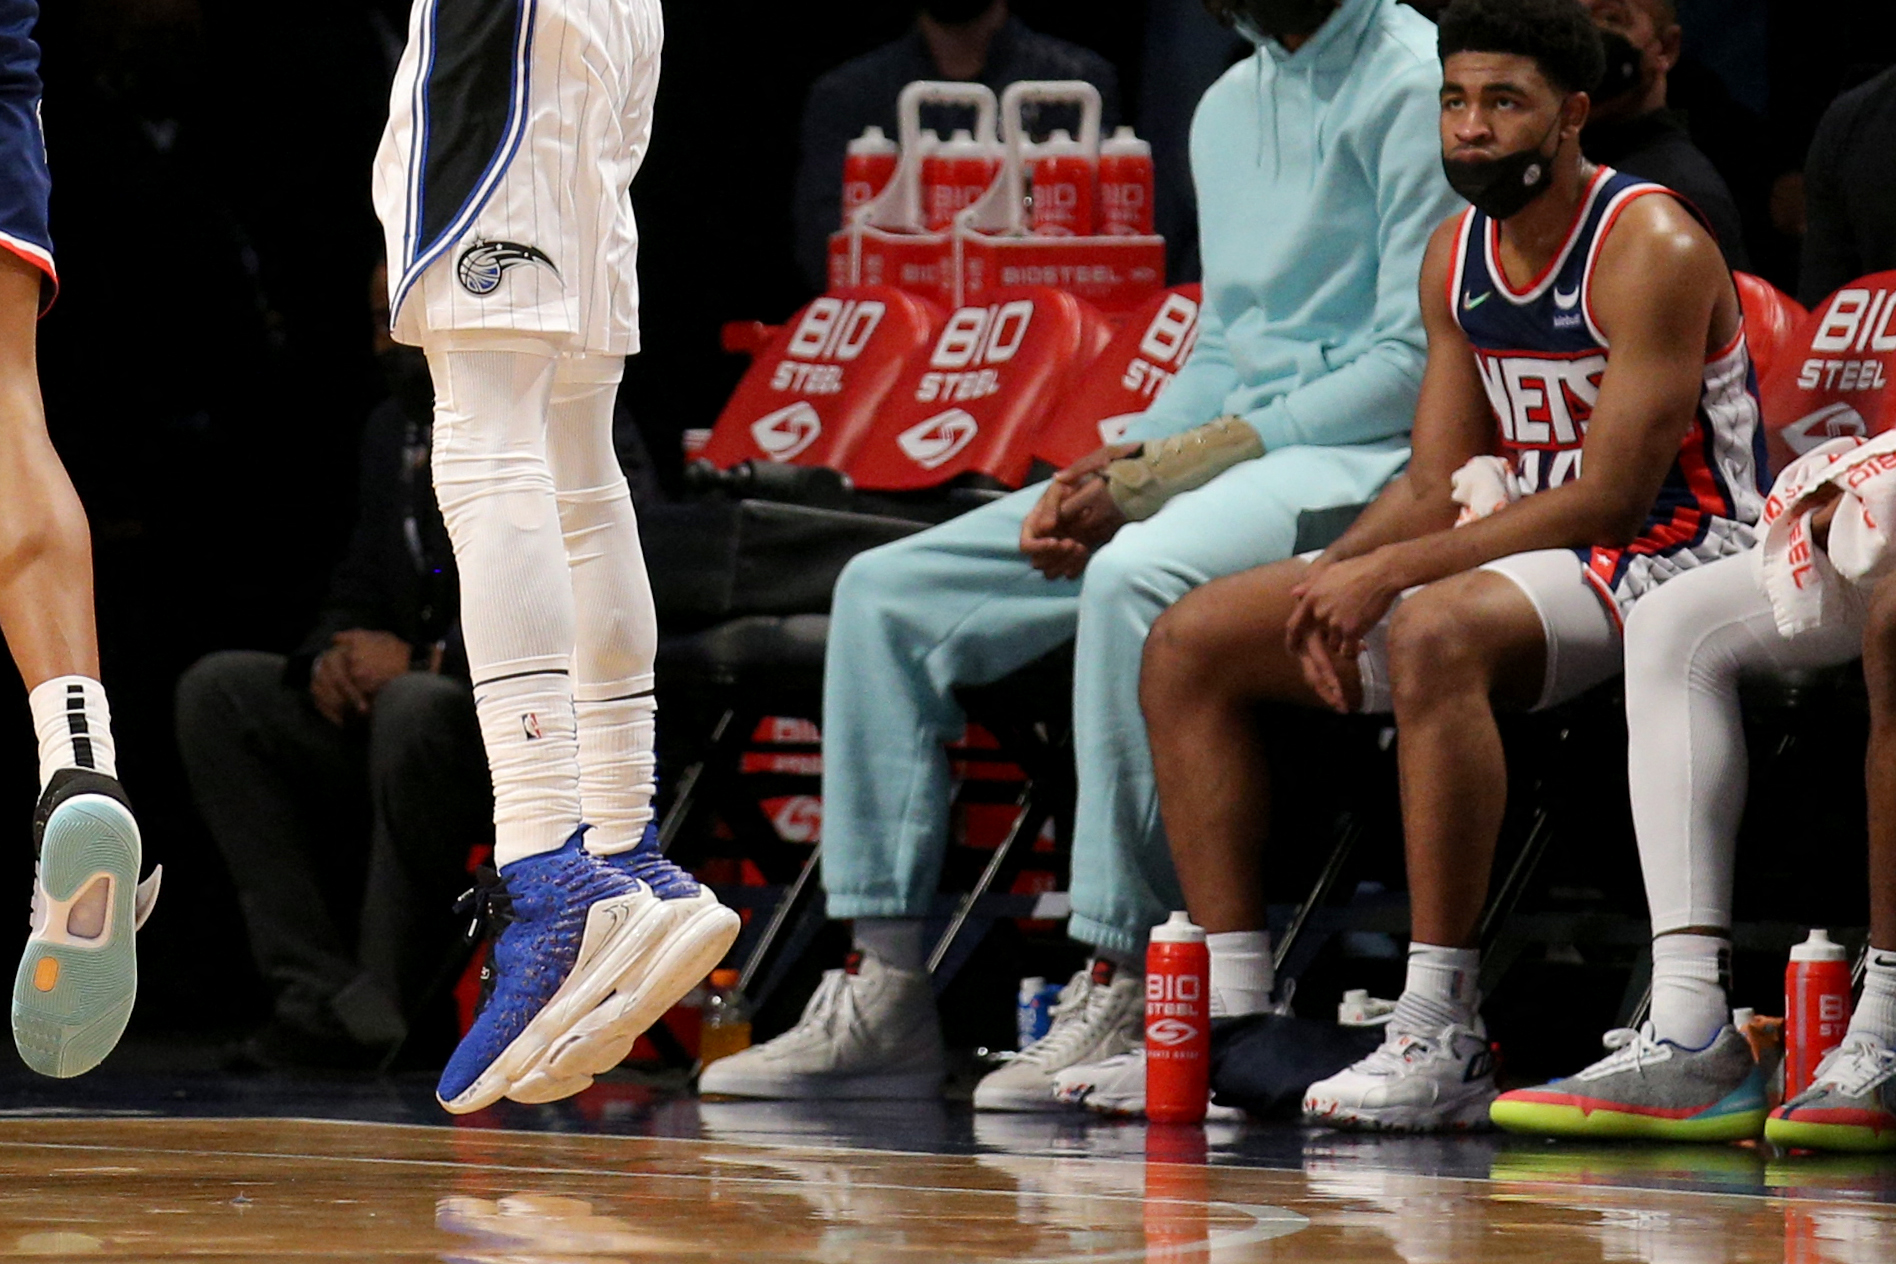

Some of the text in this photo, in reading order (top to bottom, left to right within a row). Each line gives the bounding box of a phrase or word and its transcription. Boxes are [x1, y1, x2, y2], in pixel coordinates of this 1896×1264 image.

[787, 296, 886, 359] BIO
[930, 299, 1035, 368] BIO
[769, 360, 844, 395] STEEL
[915, 367, 1000, 402] STEEL
[1796, 359, 1888, 391] STEEL
[1145, 973, 1200, 1001] BIO
